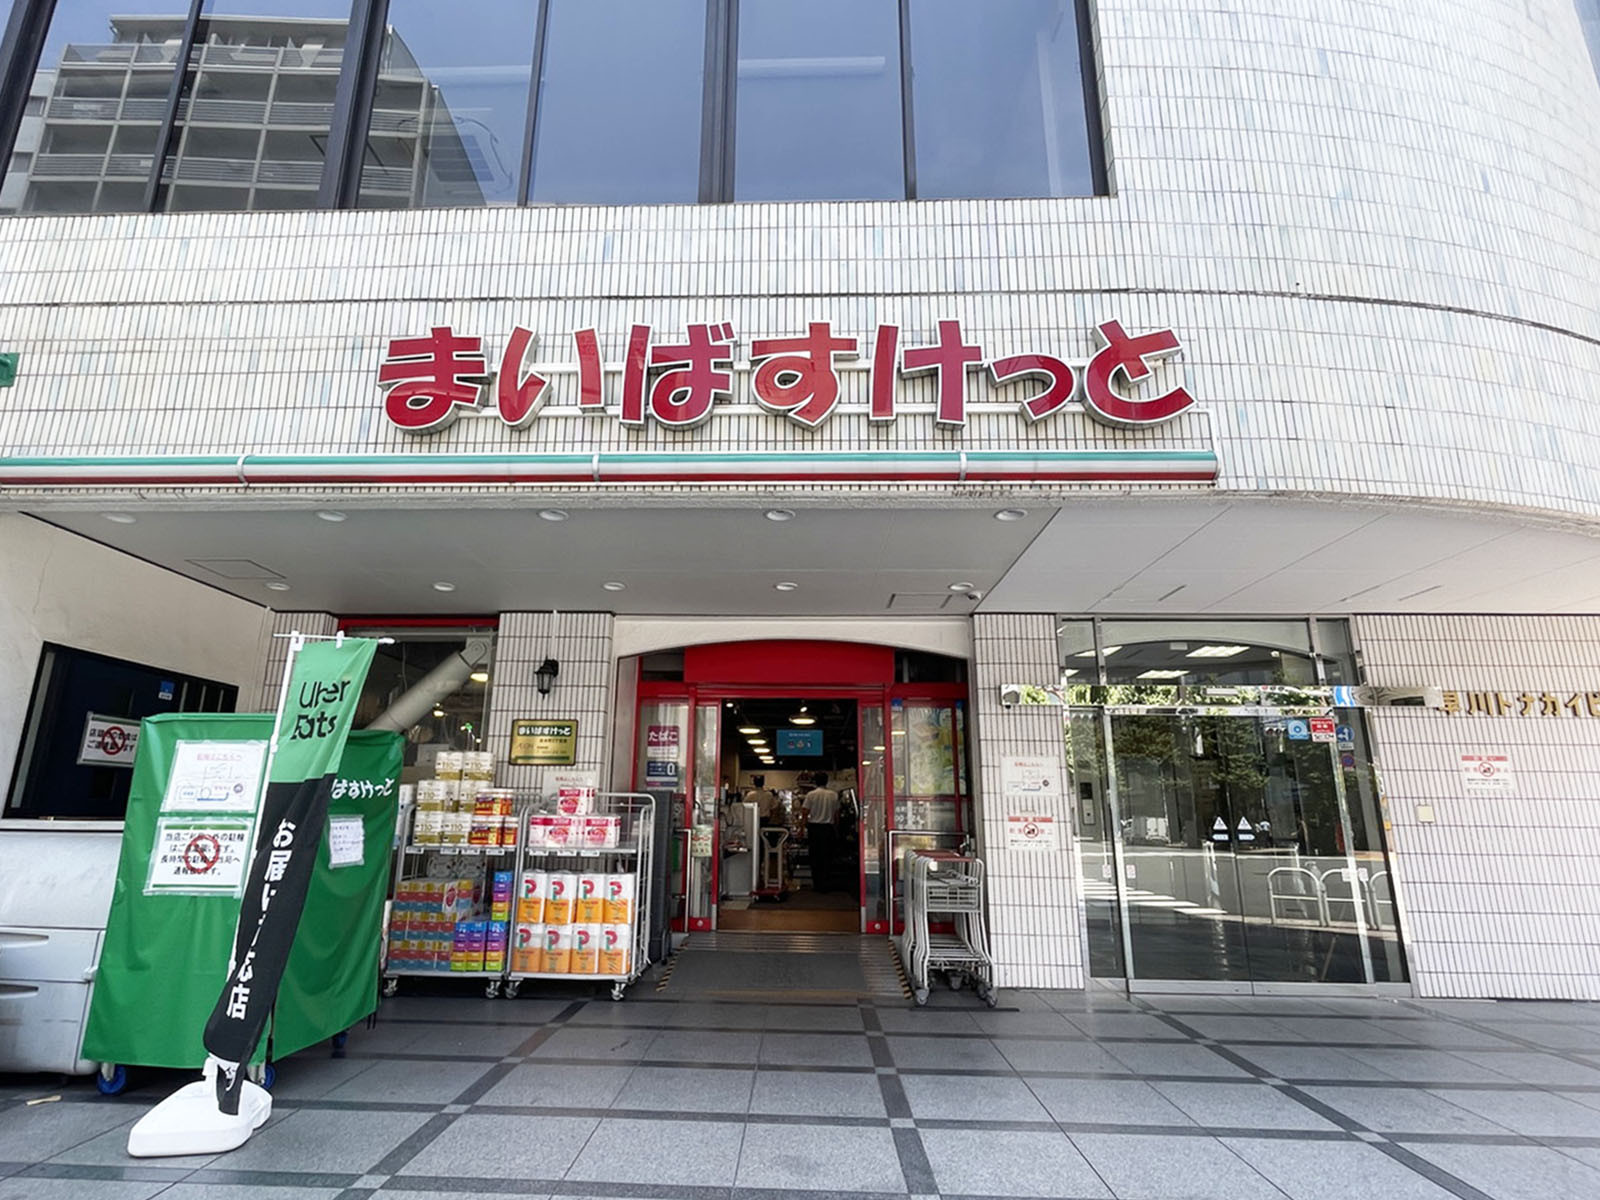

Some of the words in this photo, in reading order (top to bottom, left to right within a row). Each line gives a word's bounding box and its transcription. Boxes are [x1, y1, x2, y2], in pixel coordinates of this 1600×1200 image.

[380, 319, 1195, 431] まいばすけっと
[648, 731, 678, 742] たばこ
